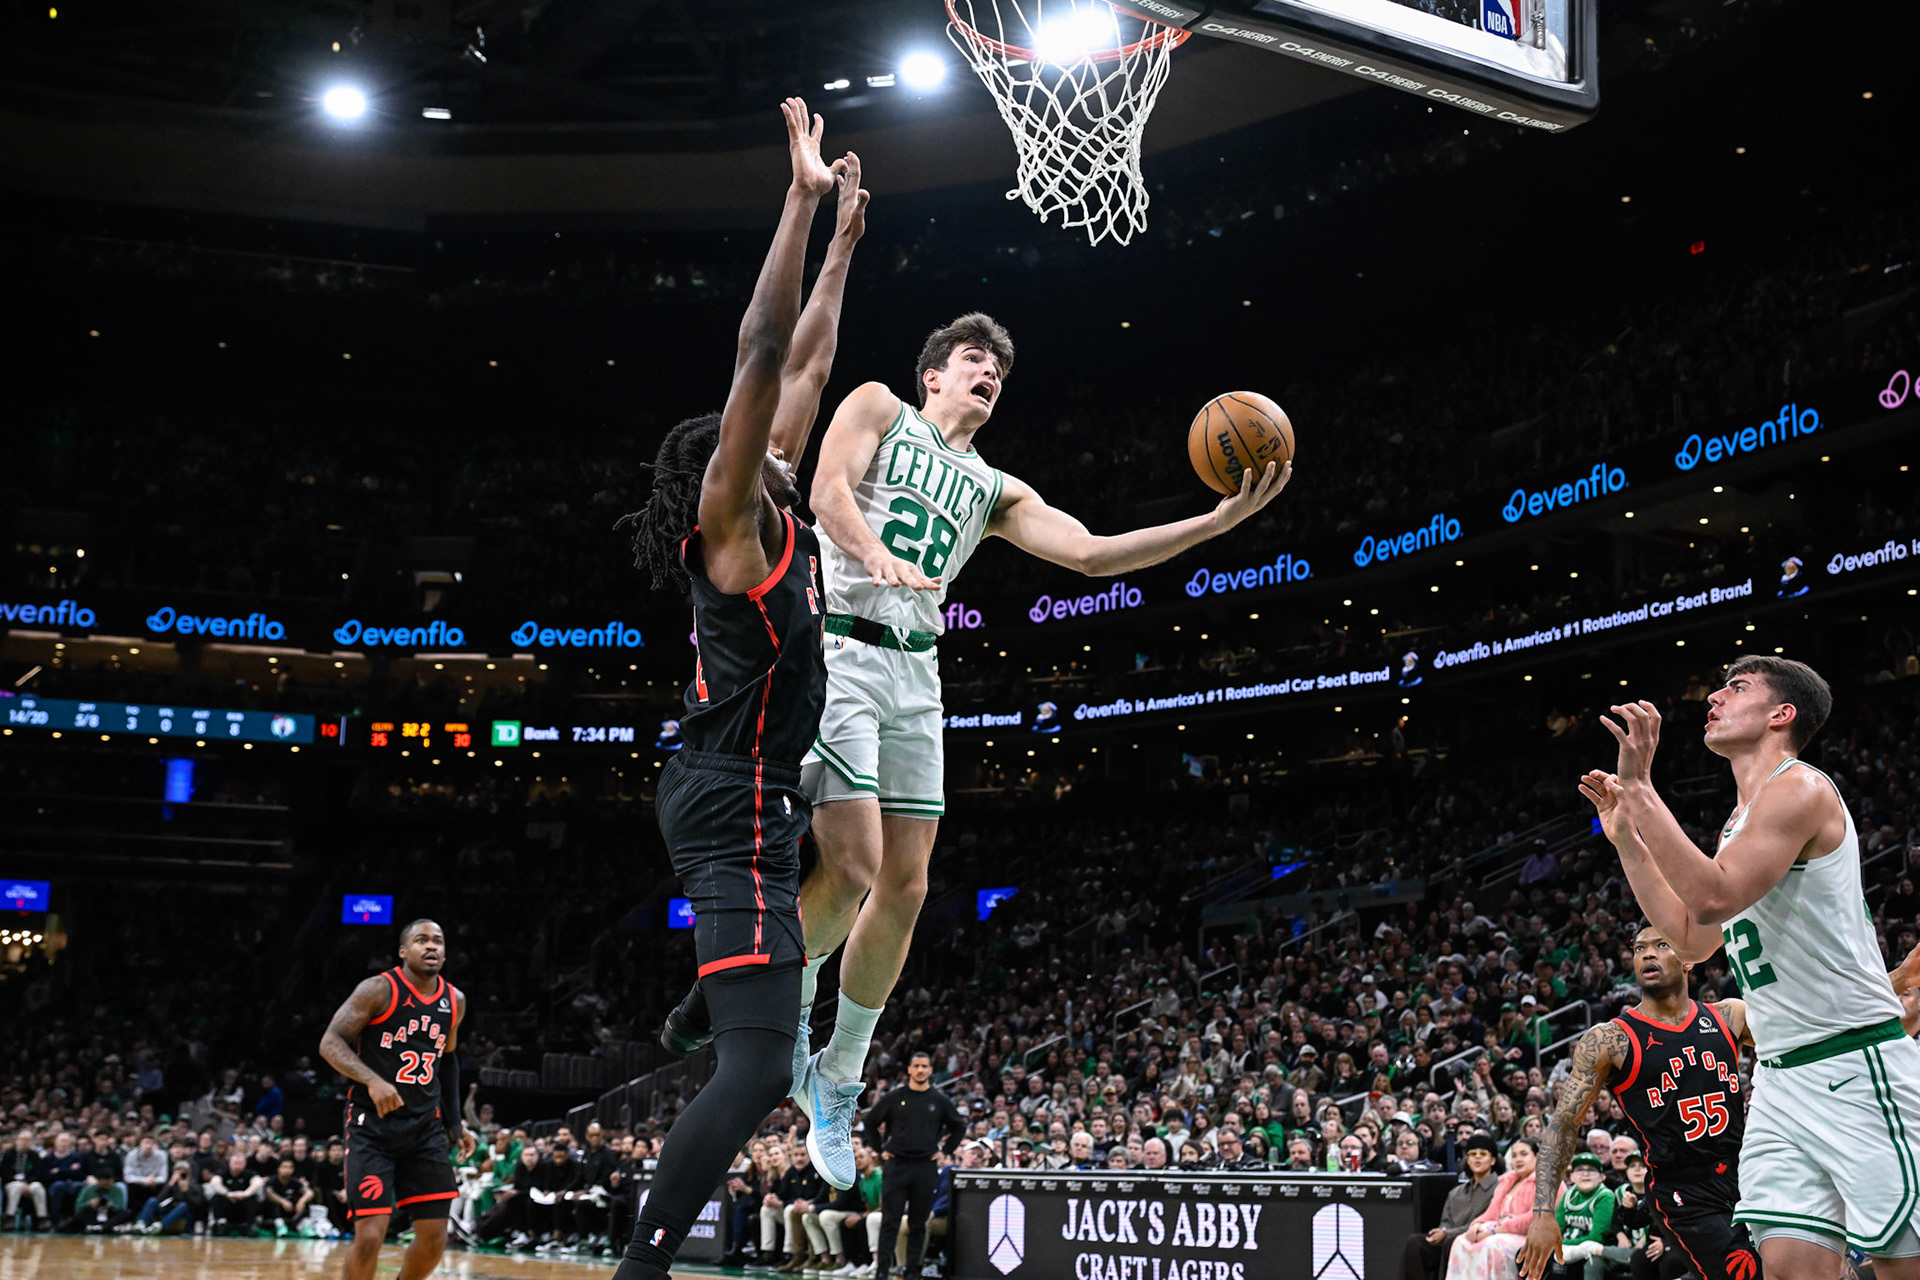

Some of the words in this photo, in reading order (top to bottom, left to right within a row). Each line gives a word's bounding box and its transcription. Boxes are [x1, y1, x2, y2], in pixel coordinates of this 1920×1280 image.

[1138, 0, 1184, 18] ENERGY
[1487, 10, 1508, 35] NBA
[1202, 23, 1236, 36] C4
[1234, 28, 1279, 44] ENERGY
[1279, 41, 1314, 57] C4
[1310, 51, 1353, 67] ENERGY
[1354, 65, 1387, 80] C4
[1385, 74, 1427, 91] ENERGY
[1427, 88, 1459, 102] C4
[1456, 97, 1497, 114] ENERGY
[1497, 111, 1527, 124] C4
[1525, 118, 1564, 131] ENERGY
[1705, 403, 1819, 462] evenflo
[885, 440, 985, 533] CELTICS
[1528, 463, 1627, 514] evenflo
[880, 496, 957, 578] 28
[1376, 514, 1460, 561] evenflo
[1844, 540, 1907, 572] evenflo
[1212, 554, 1311, 593] evenflo
[0, 600, 95, 627] venflo
[1053, 582, 1141, 619] evenflo
[177, 613, 284, 640] evenflo
[362, 621, 464, 646] evenflo
[539, 622, 642, 647] evenflo
[1446, 642, 1490, 666] evenflo
[1563, 621, 1580, 638] #1
[1583, 604, 1648, 633] Rotational
[1650, 602, 1674, 617] Car
[1676, 592, 1708, 611] Seat
[1710, 578, 1752, 603] Brand
[1087, 698, 1132, 719] evenflo
[1206, 688, 1223, 703] #1
[1226, 679, 1290, 701] Rotational
[1292, 679, 1315, 692] Car
[1317, 674, 1347, 689] Seat
[1350, 666, 1389, 685] Brand
[126, 716, 138, 730] 3
[320, 723, 338, 737] 10
[950, 714, 980, 728] Seat
[982, 711, 1021, 727] Brand
[523, 726, 559, 741] Bank
[572, 726, 606, 742] 7:34
[609, 727, 635, 742] PM
[396, 1050, 436, 1085] 23
[1648, 1046, 1739, 1108] RAPTORS
[1677, 1091, 1730, 1142] 55
[1062, 1198, 1166, 1246] JACK'S
[1171, 1201, 1263, 1251] ABBY
[1075, 1253, 1147, 1280] CRAFT
[1152, 1257, 1245, 1280] LAGERS
